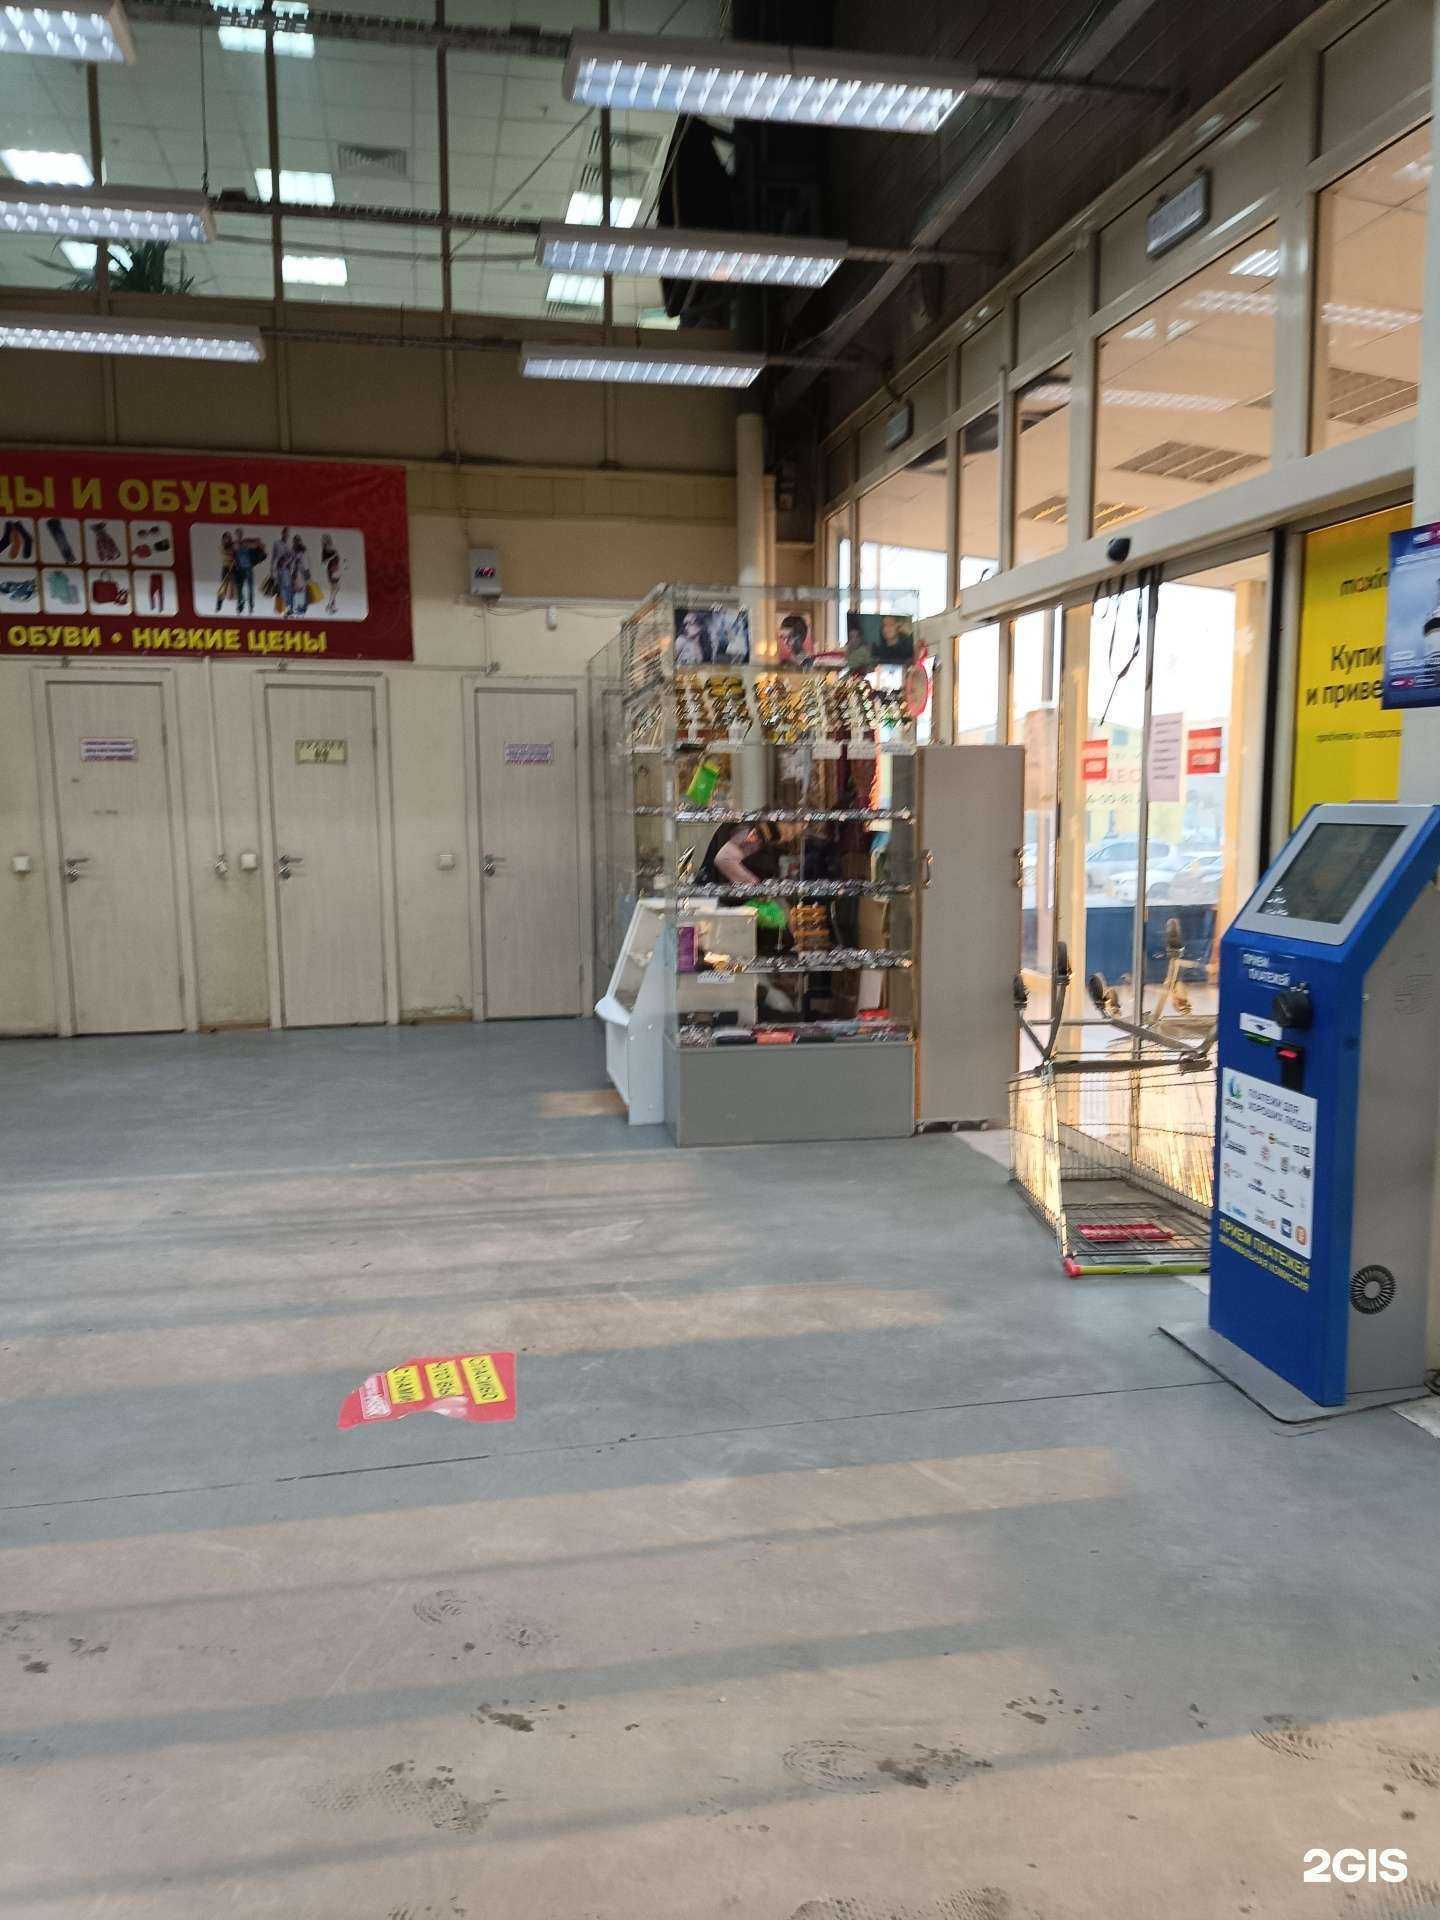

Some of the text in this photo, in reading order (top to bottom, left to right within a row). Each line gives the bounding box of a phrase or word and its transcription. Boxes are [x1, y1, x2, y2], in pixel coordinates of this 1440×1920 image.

[72, 477, 102, 510] И
[118, 479, 270, 517] ОБУВИ
[8, 625, 328, 655] ОБУВИ НИЗКИЕ ЦЕНЫ
